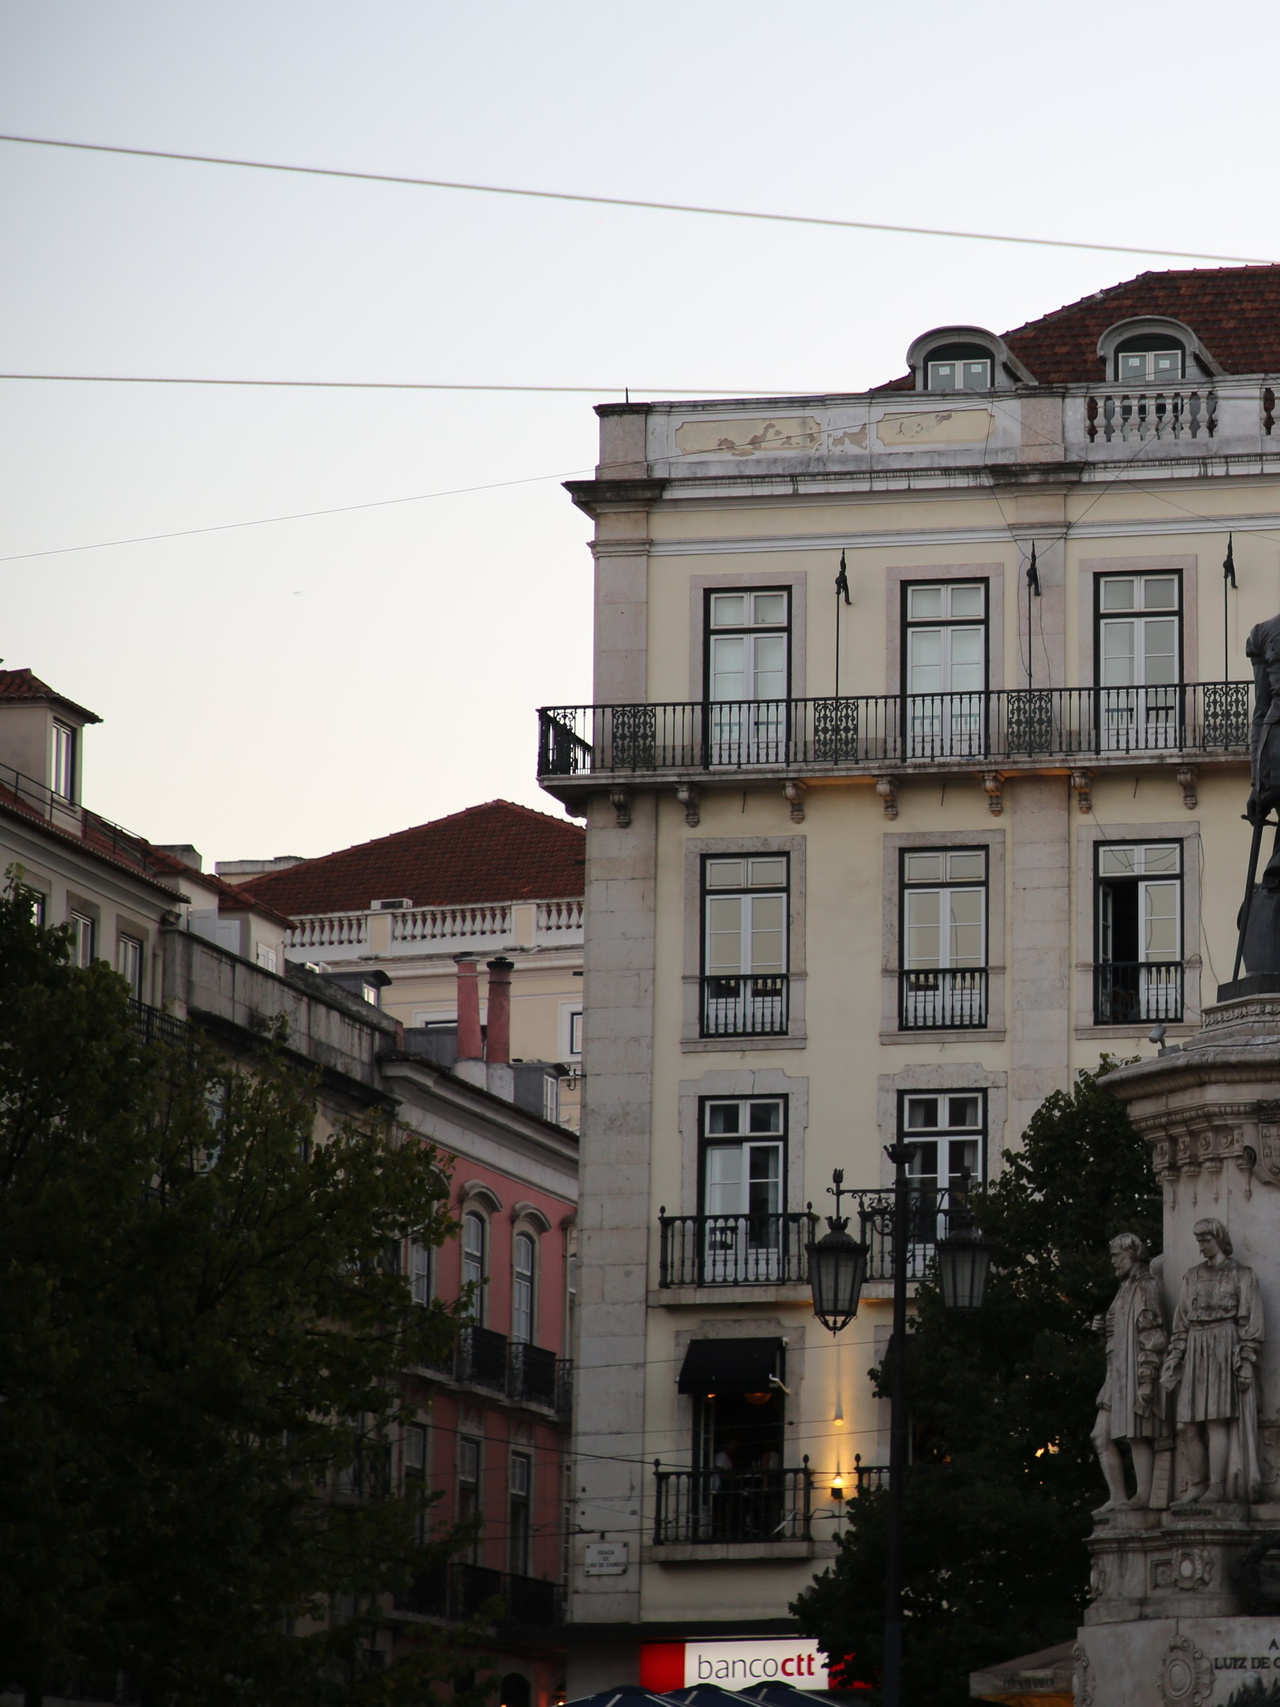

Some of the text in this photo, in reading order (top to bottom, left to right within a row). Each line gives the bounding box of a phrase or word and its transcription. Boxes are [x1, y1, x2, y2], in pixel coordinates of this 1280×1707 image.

[1268, 1637, 1279, 1650] A
[1214, 1656, 1247, 1670] LUIZ
[1251, 1656, 1270, 1669] DE
